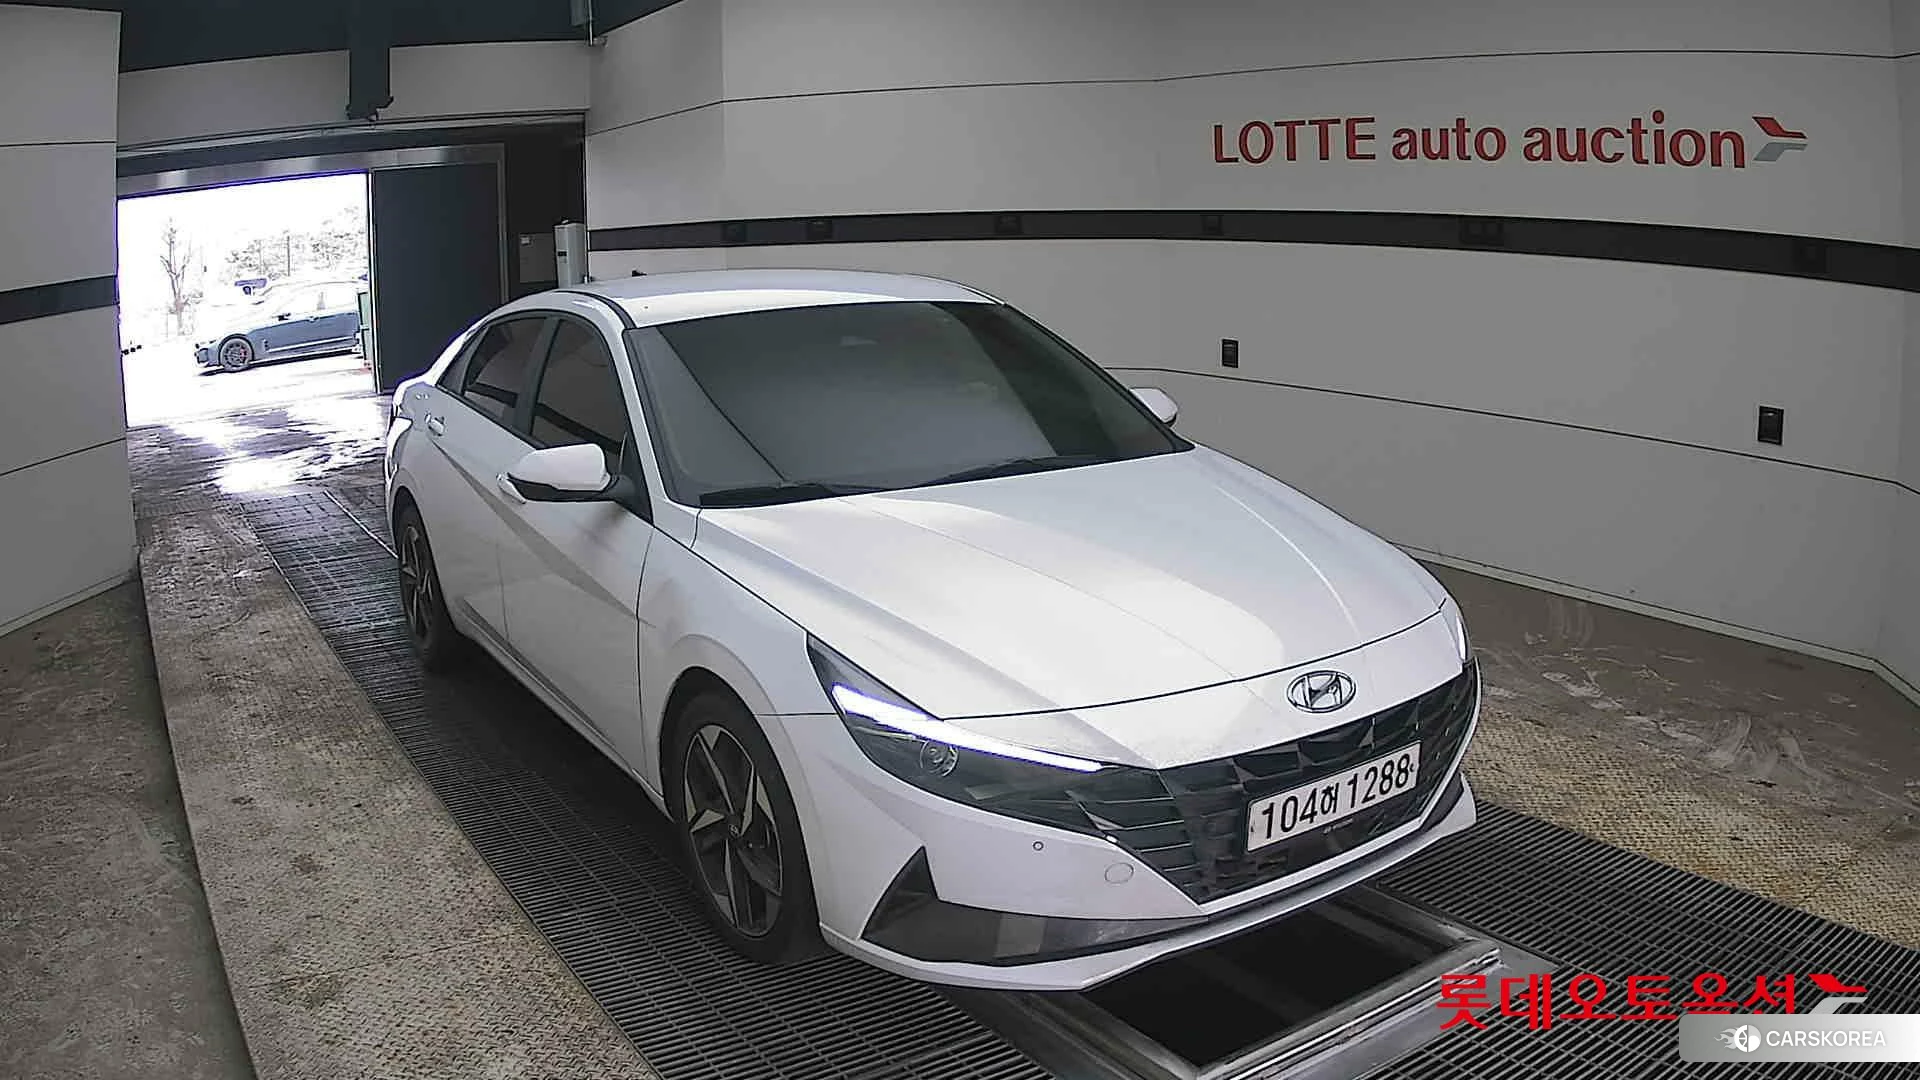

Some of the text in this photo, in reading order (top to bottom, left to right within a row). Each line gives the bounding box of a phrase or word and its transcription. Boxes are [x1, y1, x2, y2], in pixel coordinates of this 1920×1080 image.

[1212, 110, 1746, 168] LOTTE auto auction
[1262, 753, 1411, 839] 104허 1288
